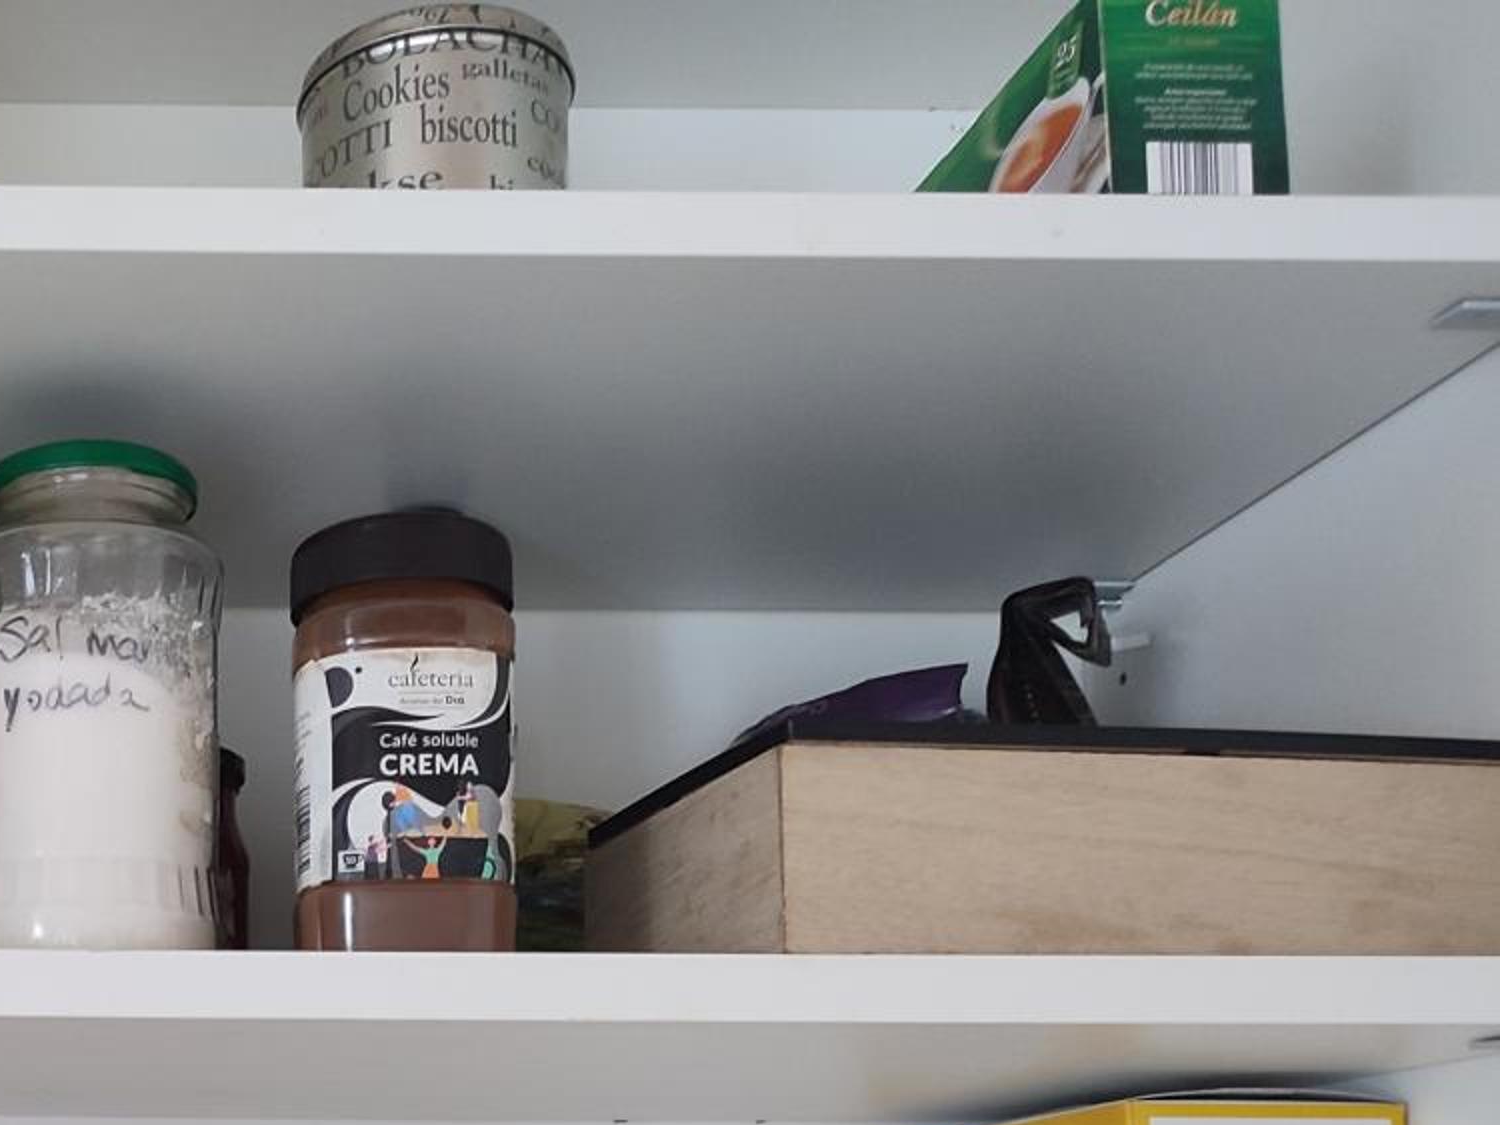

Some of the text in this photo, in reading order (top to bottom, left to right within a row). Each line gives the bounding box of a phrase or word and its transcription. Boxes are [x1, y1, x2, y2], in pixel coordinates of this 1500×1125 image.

[343, 63, 450, 121] Cookies
[420, 103, 518, 149] biscotti
[379, 732, 480, 749] Café soluble
[379, 752, 480, 777] CREMA
